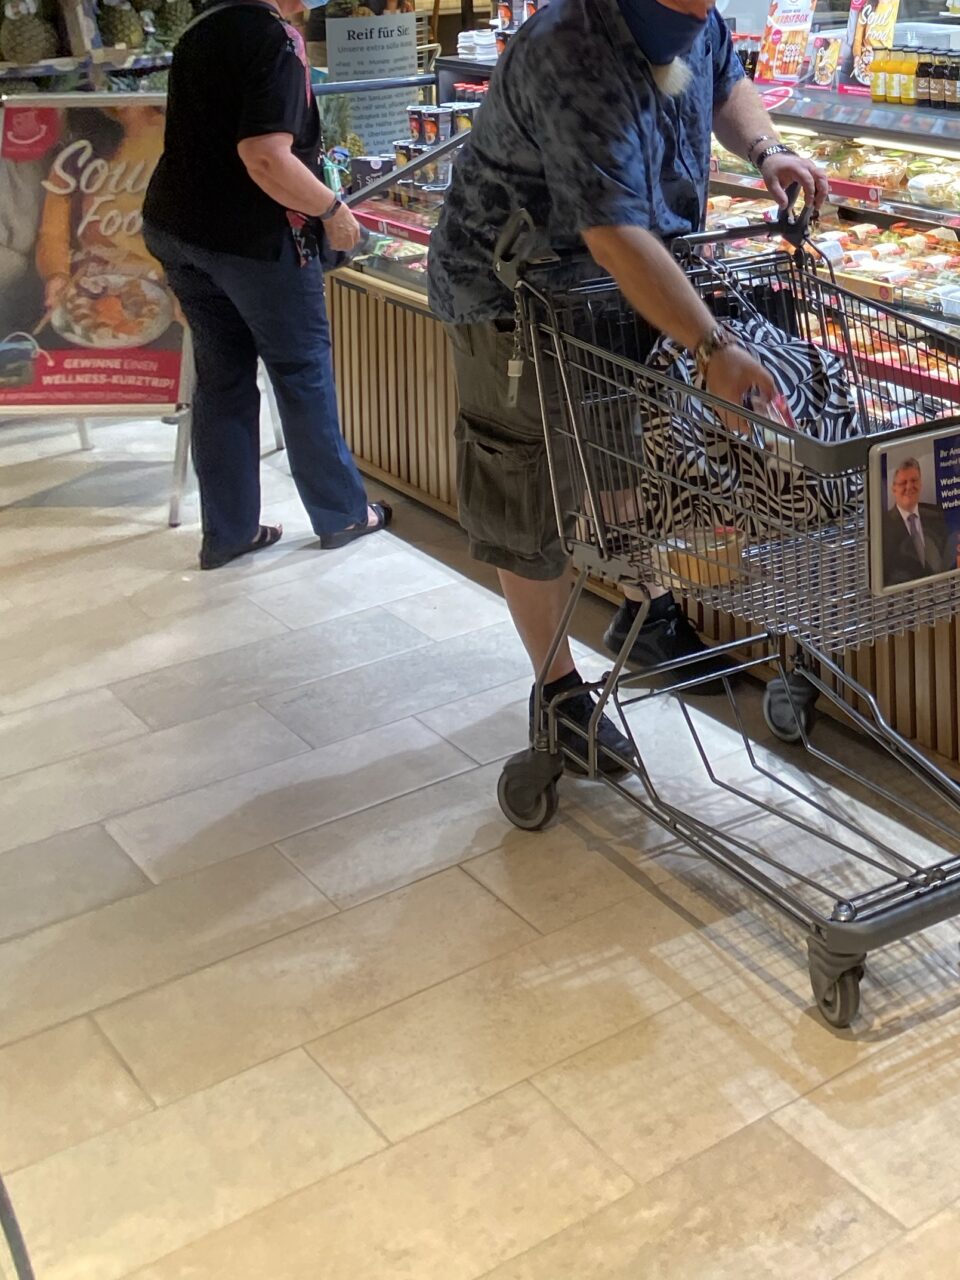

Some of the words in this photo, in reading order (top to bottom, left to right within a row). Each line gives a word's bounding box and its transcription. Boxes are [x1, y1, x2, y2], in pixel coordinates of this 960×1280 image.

[347, 28, 374, 41] Reif
[378, 27, 395, 39] für
[41, 140, 150, 195] Sou
[77, 194, 143, 236] Foo
[63, 359, 122, 370] GEWINNE
[123, 359, 158, 371] EINEN
